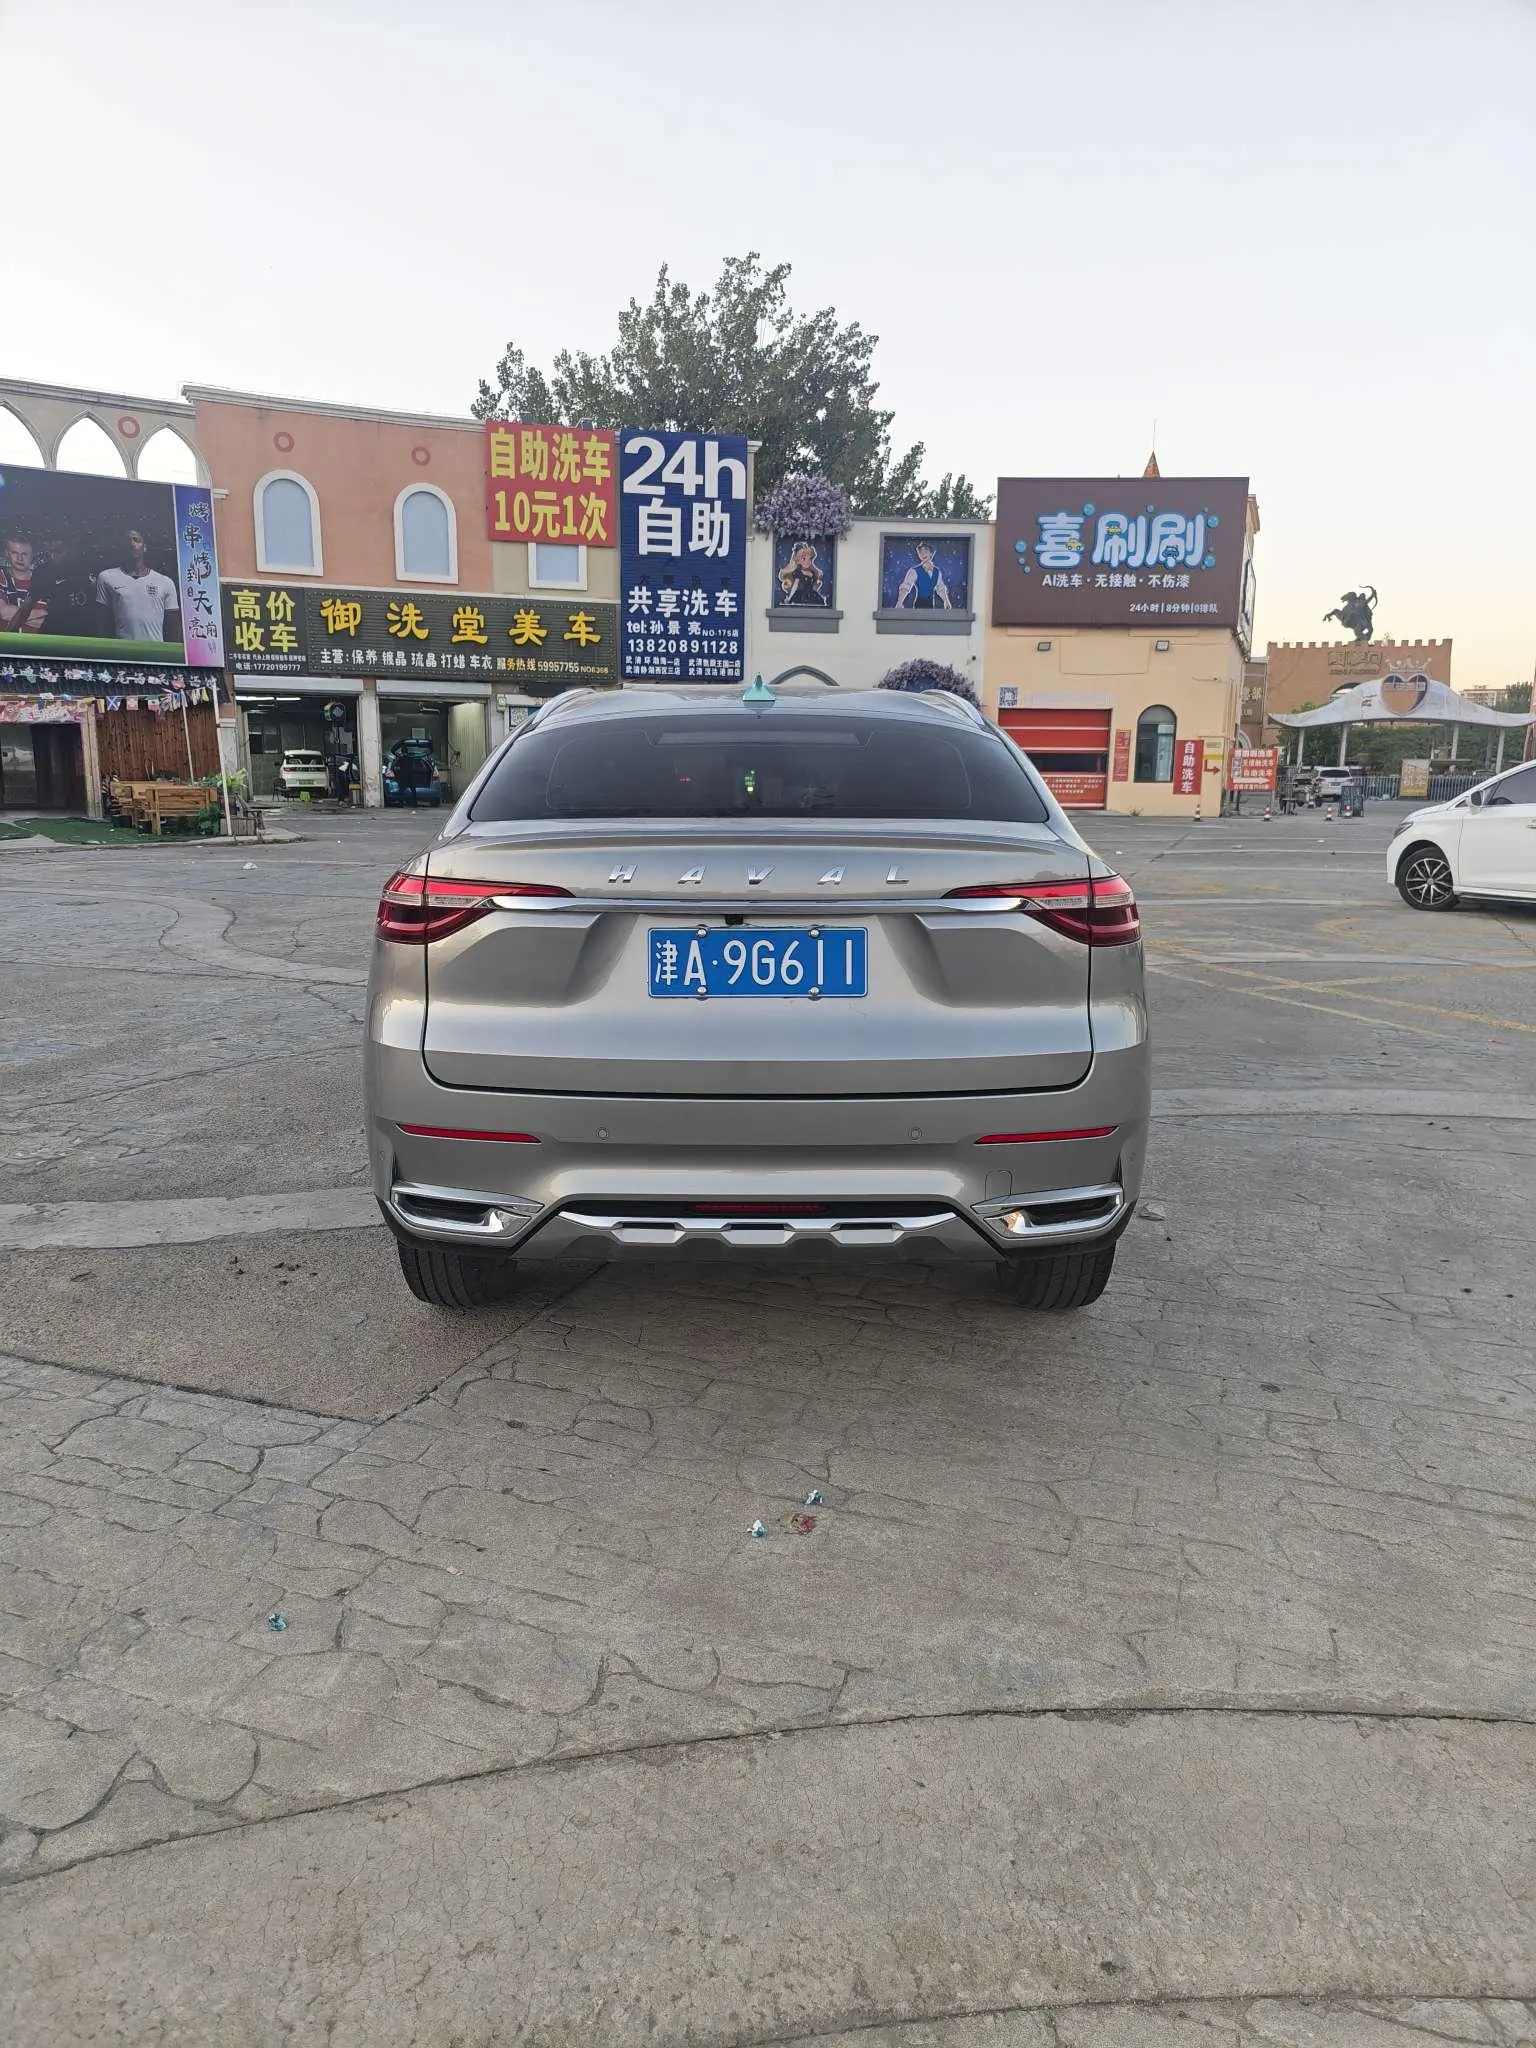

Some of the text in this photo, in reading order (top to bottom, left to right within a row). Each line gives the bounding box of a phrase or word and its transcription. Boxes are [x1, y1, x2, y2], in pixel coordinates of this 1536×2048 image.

[490, 427, 611, 486] 自助洗车
[623, 436, 747, 499] 24h
[494, 489, 609, 542] 10元1次
[637, 499, 731, 558] 自助
[1033, 511, 1206, 569] 喜刷刷
[230, 589, 296, 622] 高价
[319, 597, 603, 648] 御洗堂美车
[627, 585, 738, 618] 共享洗车
[235, 622, 299, 653] 收车
[440, 653, 466, 669] 打蜡
[469, 655, 493, 671] 车衣
[627, 638, 738, 655] 13820891128
[1180, 741, 1196, 794] 自助洗车
[608, 863, 911, 885] HAVAL
